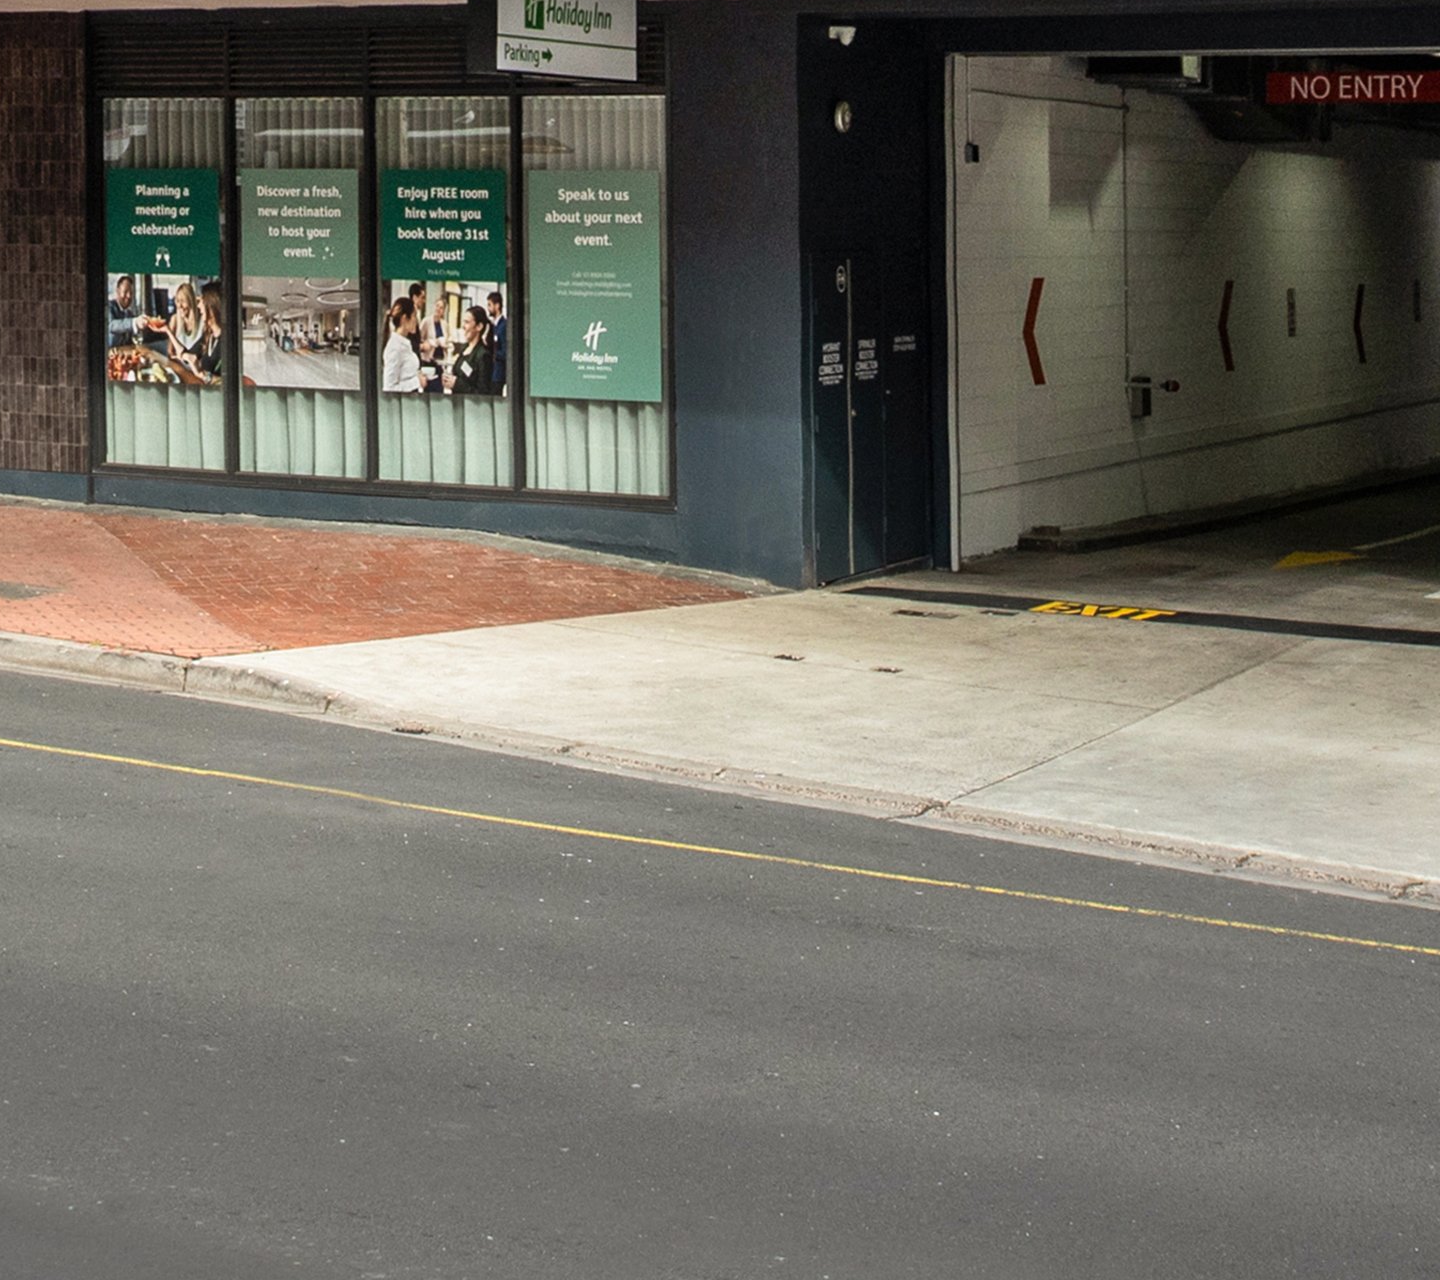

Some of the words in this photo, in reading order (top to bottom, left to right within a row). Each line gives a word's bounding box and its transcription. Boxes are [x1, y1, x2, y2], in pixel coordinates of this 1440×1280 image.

[594, 2, 612, 29] Inn
[504, 43, 541, 67] Parking
[1290, 76, 1331, 99] NO
[1338, 74, 1424, 99] ENTRY
[135, 184, 181, 199] Planning
[182, 187, 190, 197] a
[256, 186, 301, 197] Discover
[303, 188, 310, 197] a
[312, 185, 342, 199] fresh,
[397, 187, 429, 202] Enjoy
[430, 187, 458, 199] FREE
[460, 189, 489, 199] room
[557, 188, 596, 204] Speak
[598, 189, 612, 201] to
[614, 190, 630, 201] us
[135, 204, 177, 219] meeting
[179, 207, 190, 216] or
[257, 207, 279, 217] new
[280, 205, 342, 217] destination
[405, 207, 427, 219] hire
[429, 207, 458, 219] when
[460, 210, 482, 222] you
[545, 210, 581, 223] about
[584, 212, 613, 227] your
[615, 212, 643, 224] next
[131, 223, 195, 236] celebration?
[268, 226, 280, 237] to
[281, 225, 304, 237] host
[306, 227, 331, 241] your
[397, 226, 425, 240] book
[426, 227, 463, 240] before
[464, 228, 489, 241] 31st
[574, 234, 613, 247] event.
[283, 246, 316, 258] event.
[421, 248, 465, 264] August!
[571, 351, 603, 366] Holiday
[604, 352, 619, 364] Inn
[1028, 600, 1177, 621] EXIT
